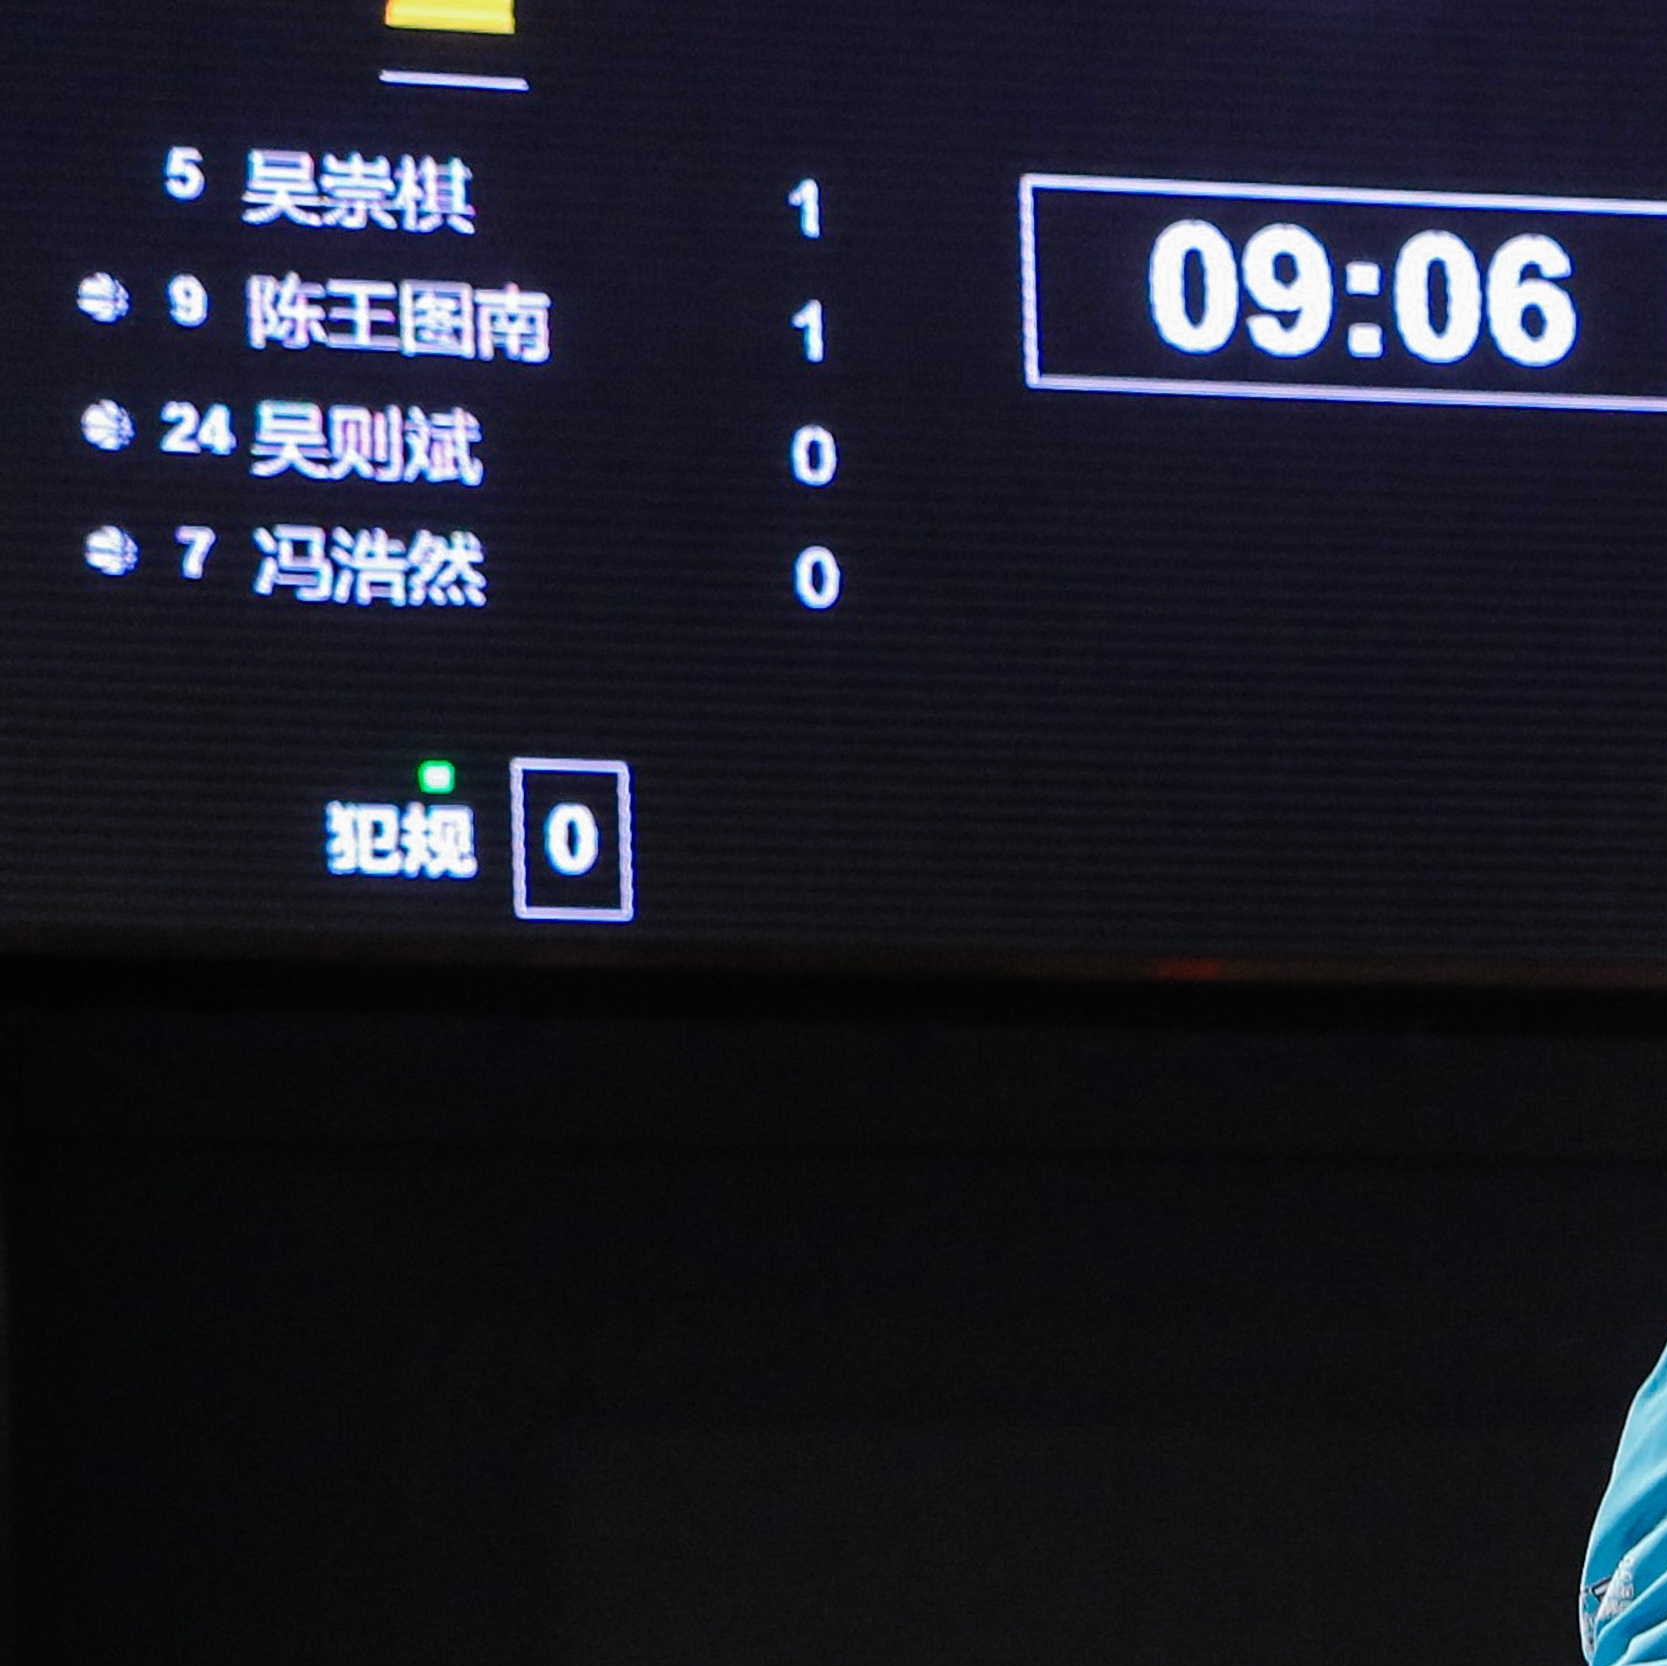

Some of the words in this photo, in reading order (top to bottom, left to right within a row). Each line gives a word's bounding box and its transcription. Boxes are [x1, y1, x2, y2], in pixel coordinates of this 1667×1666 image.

[166, 146, 205, 198] 5
[242, 149, 475, 234] 吴崇棋
[789, 179, 820, 237] 1
[168, 274, 207, 326] 9
[247, 272, 552, 363] 陈王图南
[793, 300, 824, 362] 1
[1148, 219, 1579, 368] 09:06
[161, 401, 236, 455] 24
[251, 400, 484, 486] 吴则斌
[791, 426, 838, 486] 0
[177, 526, 216, 578] 7
[254, 524, 487, 606] 冯浩然
[794, 546, 841, 608] 0
[326, 801, 478, 877] 犯规
[545, 804, 600, 874] 0
